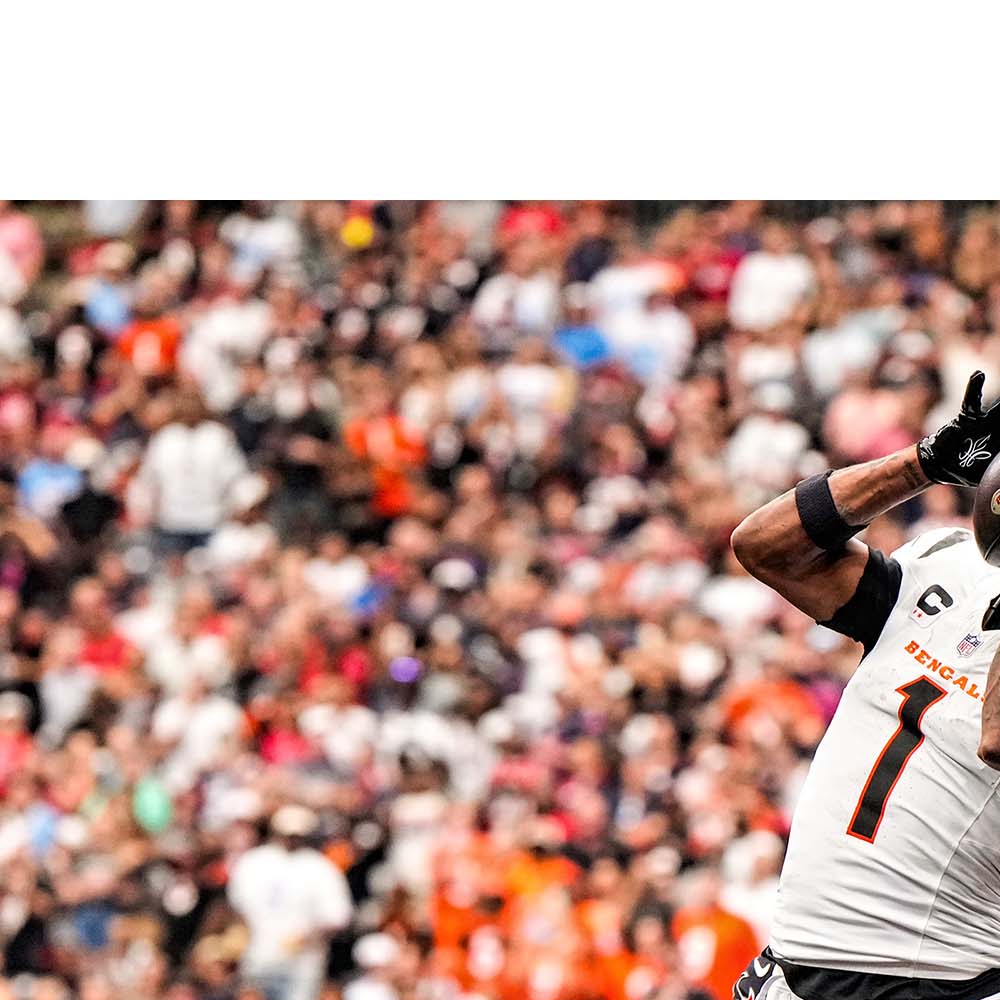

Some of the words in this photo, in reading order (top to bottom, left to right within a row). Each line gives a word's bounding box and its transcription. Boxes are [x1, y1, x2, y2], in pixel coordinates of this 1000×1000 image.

[916, 584, 954, 616] C
[904, 640, 987, 702] BENGAL
[847, 675, 949, 843] 1
